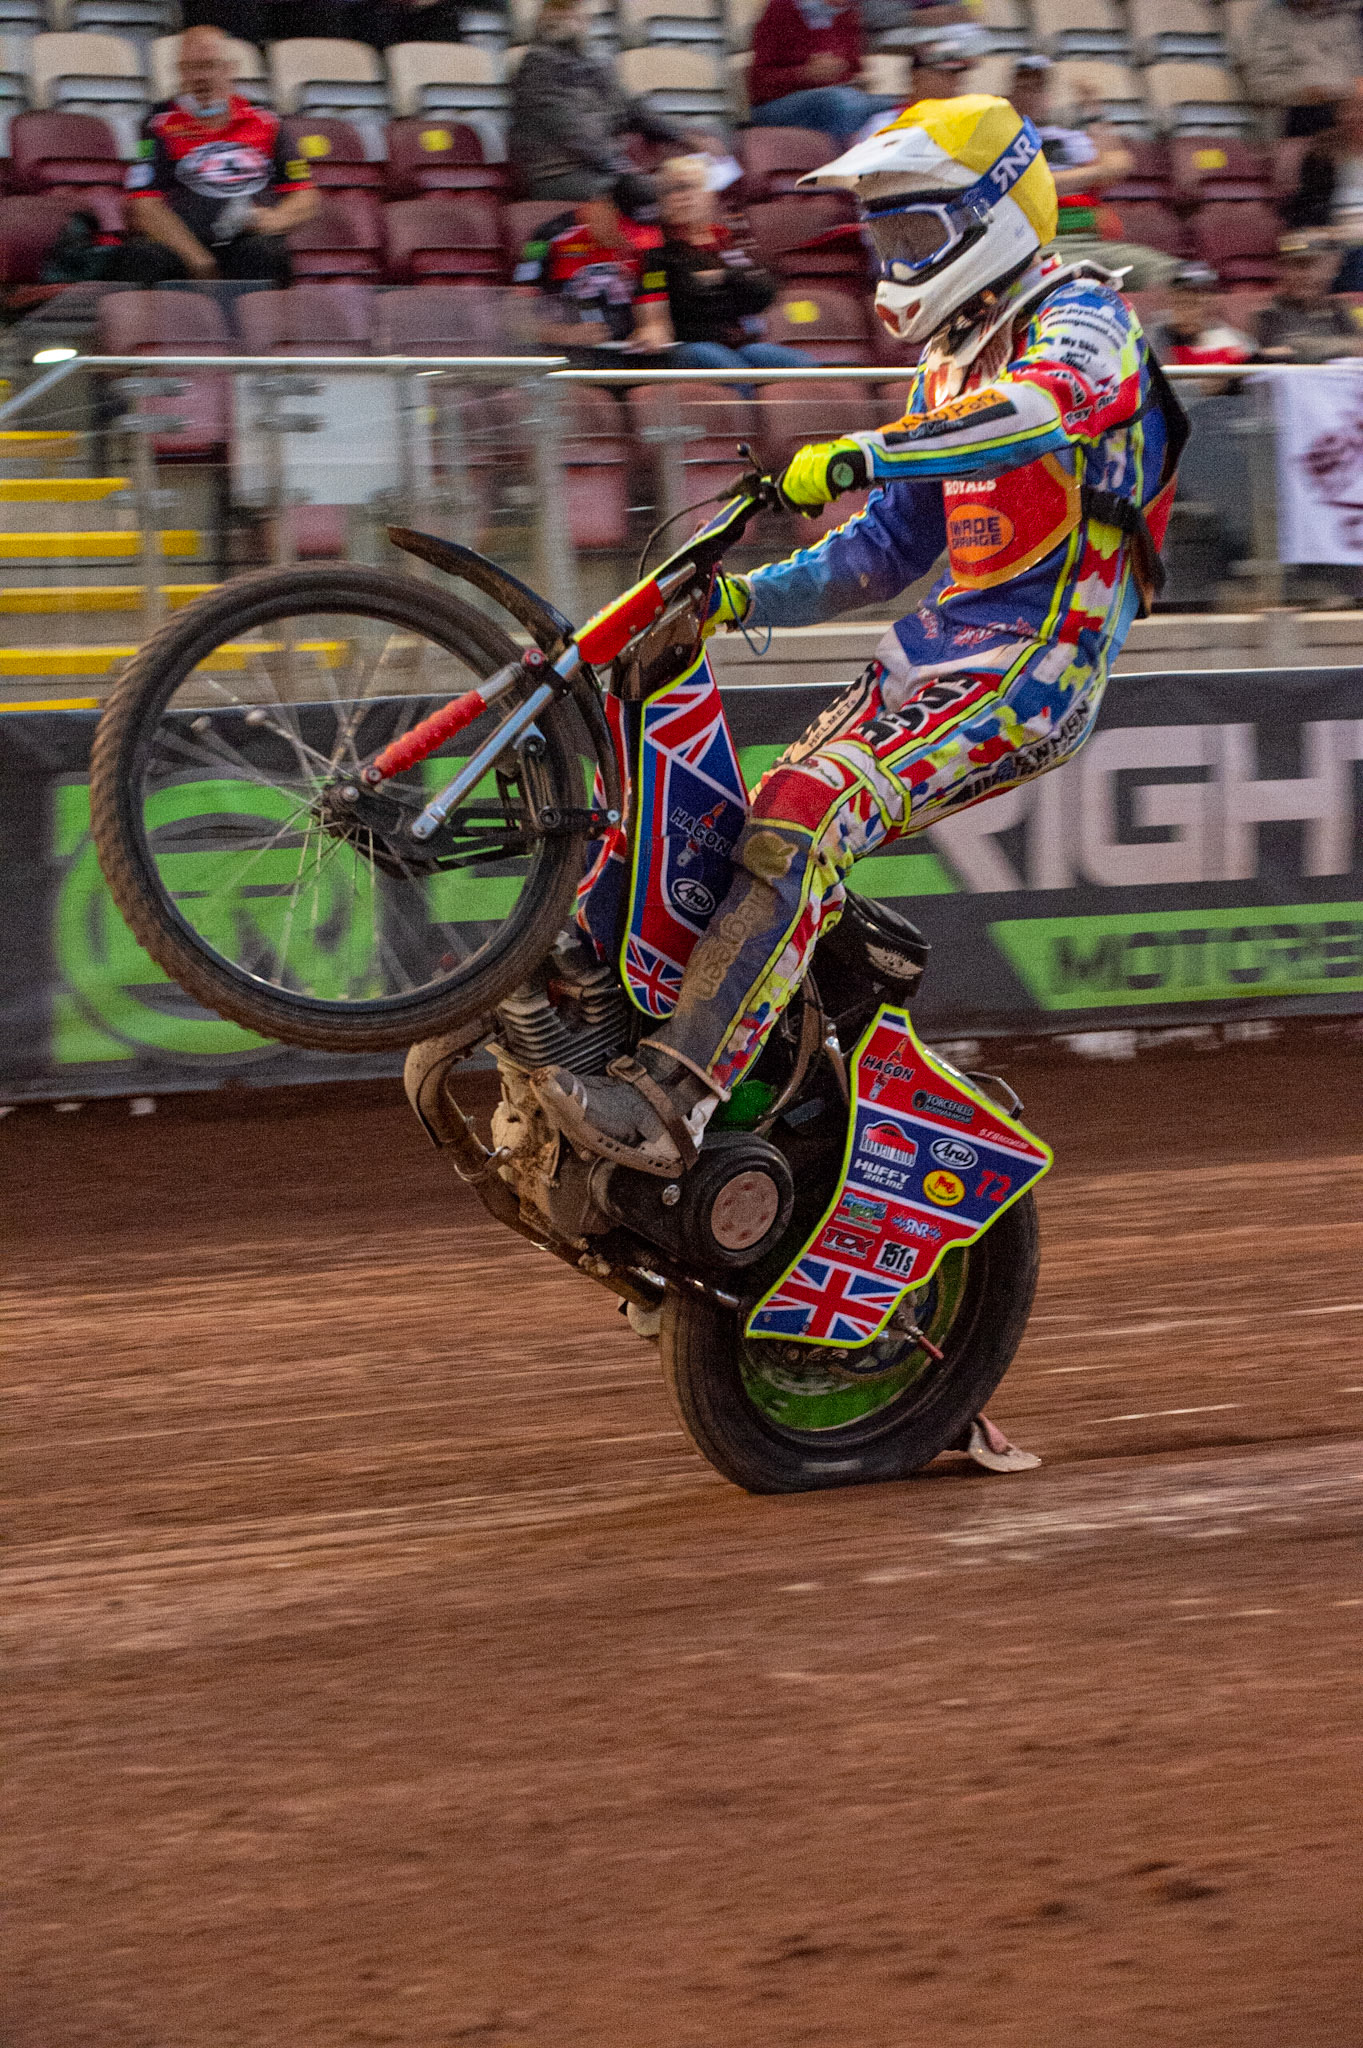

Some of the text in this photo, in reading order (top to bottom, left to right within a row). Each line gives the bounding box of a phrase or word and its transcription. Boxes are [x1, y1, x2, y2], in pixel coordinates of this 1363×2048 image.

[808, 701, 853, 750] HELMET
[670, 807, 731, 857] HAGON
[862, 1056, 914, 1082] HAGON
[854, 1158, 911, 1183] HUFFY
[862, 1172, 905, 1190] RACING
[975, 1170, 1011, 1203] 72
[880, 1240, 915, 1273] 151s
